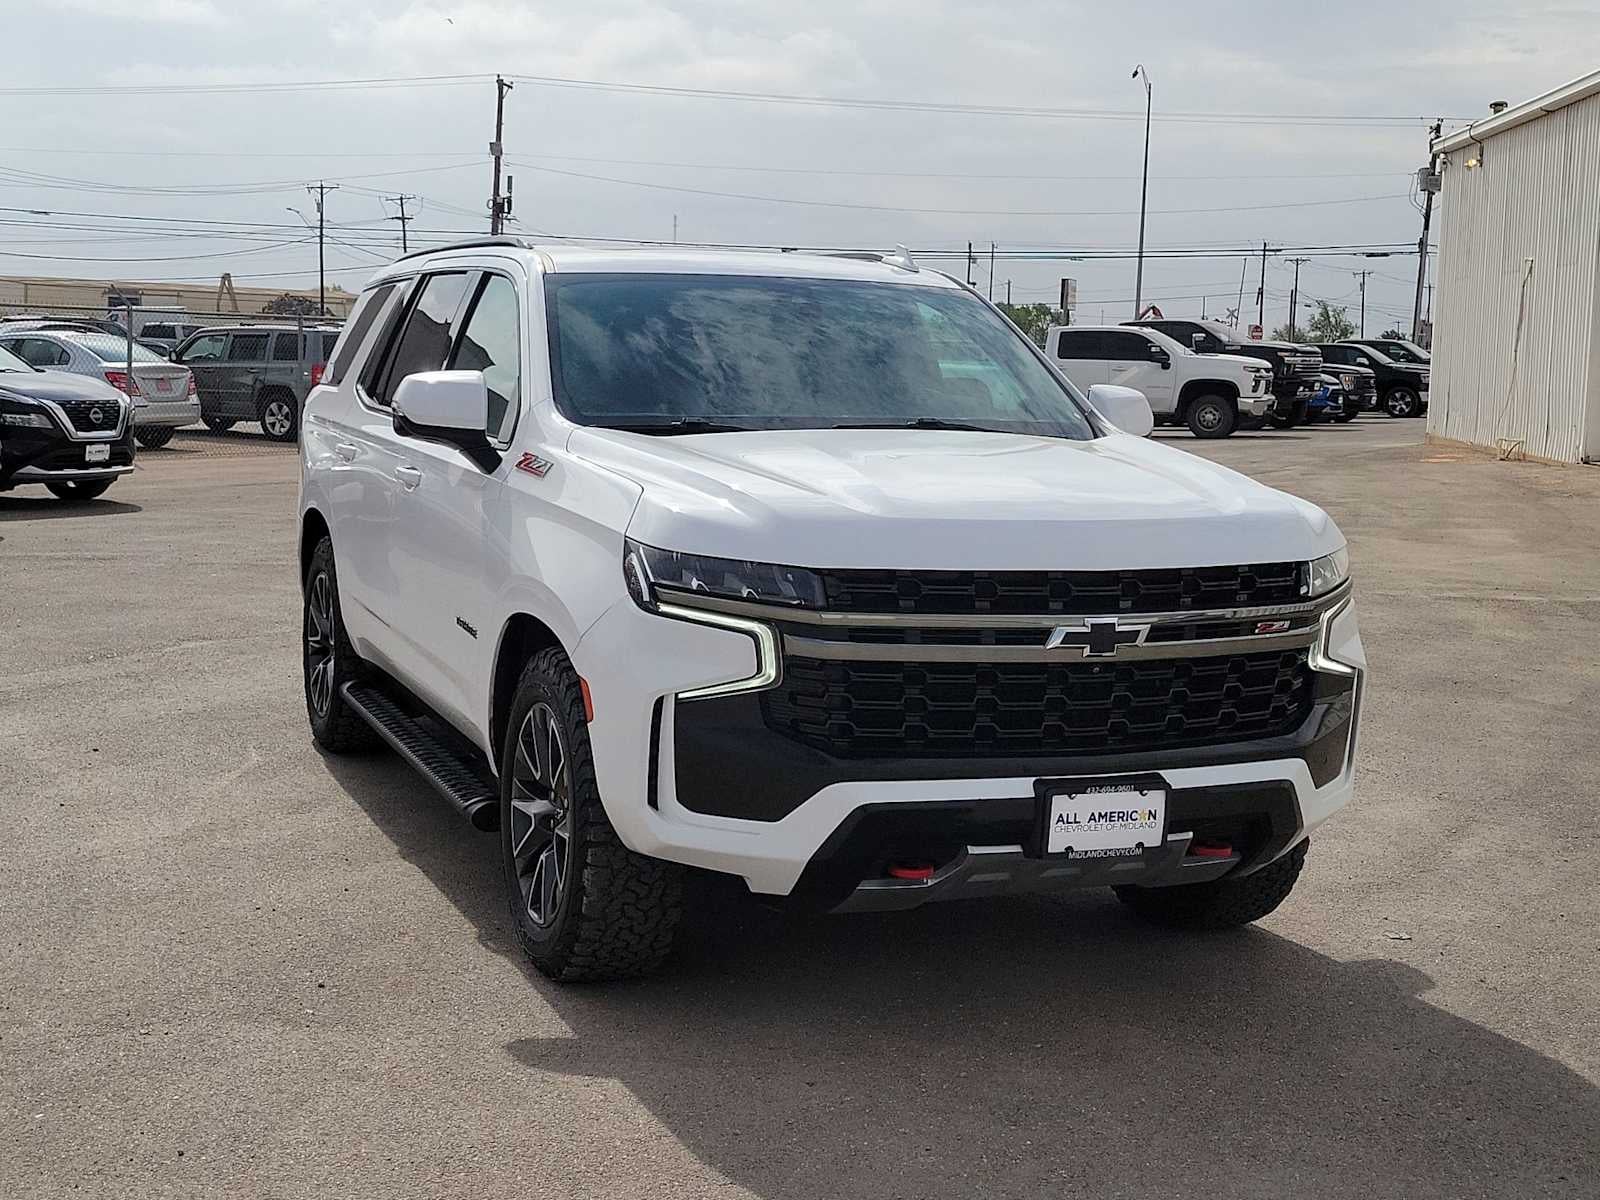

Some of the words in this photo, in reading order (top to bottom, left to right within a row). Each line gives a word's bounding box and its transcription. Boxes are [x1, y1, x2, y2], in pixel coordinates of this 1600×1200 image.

[515, 452, 554, 478] Z71
[1254, 620, 1291, 634] Z71
[1056, 813, 1081, 824] ALL
[1054, 824, 1103, 833] CHEVROLET
[1106, 823, 1117, 831] OF
[1119, 821, 1157, 830] MIDLAND
[1068, 848, 1143, 859] MIDLANDCHEVY.COM
